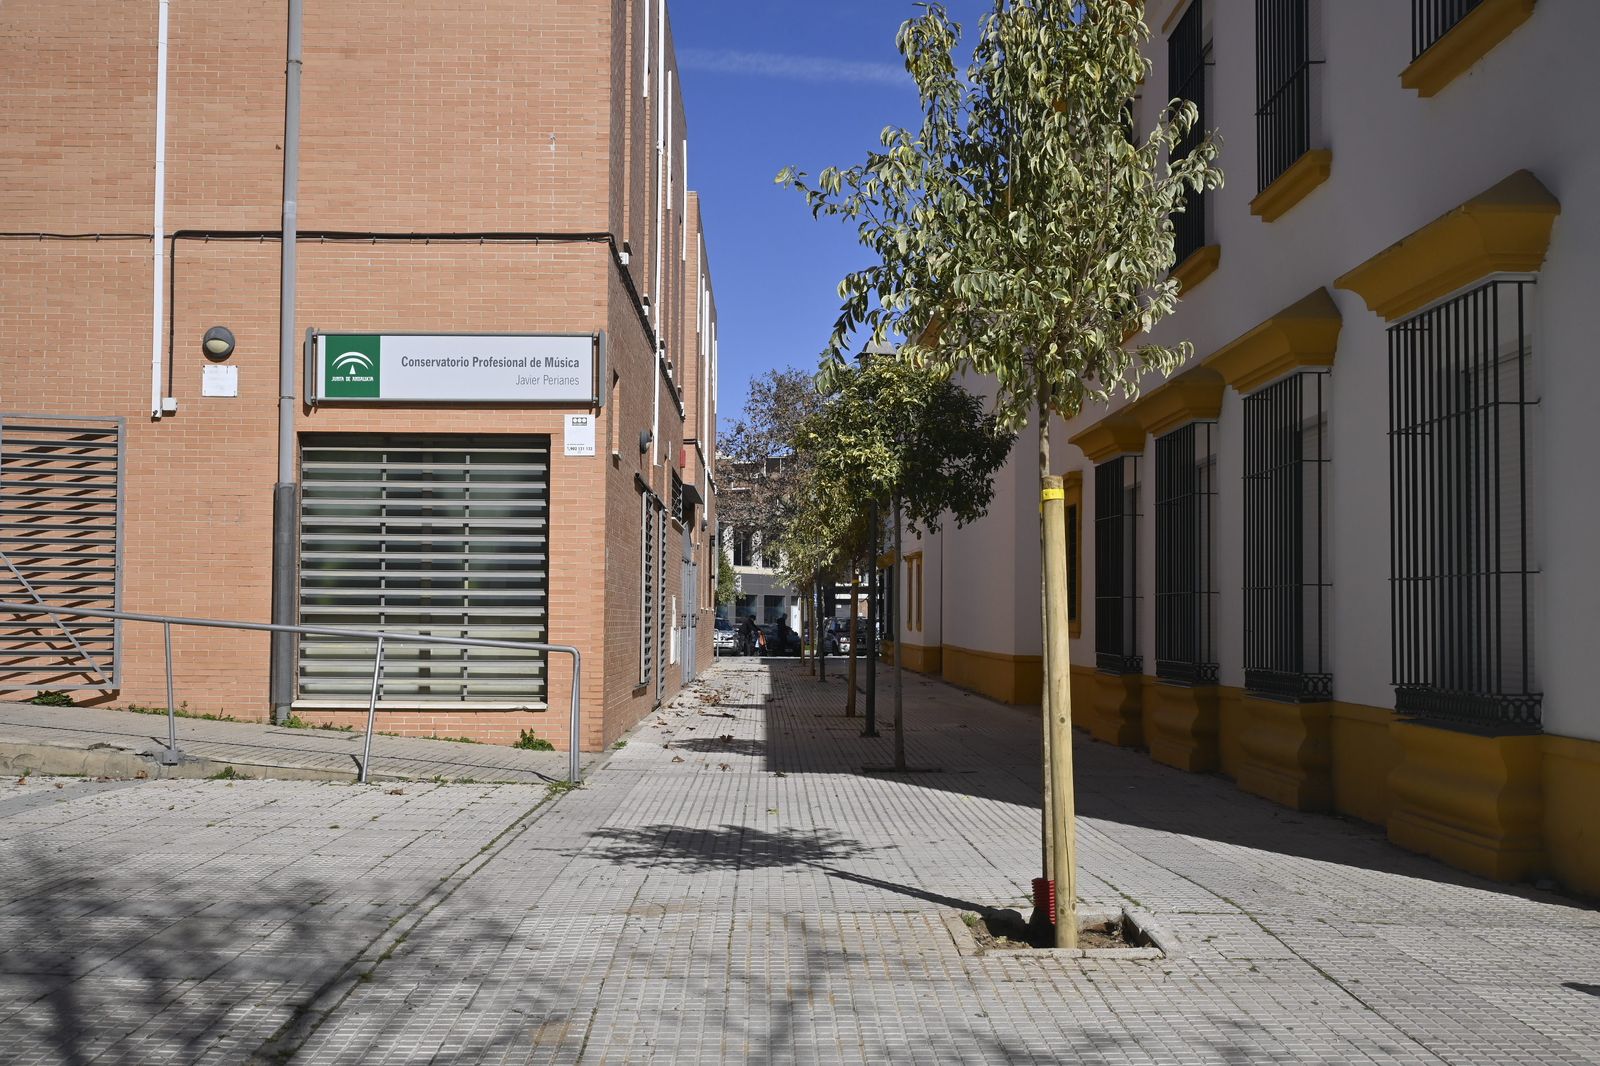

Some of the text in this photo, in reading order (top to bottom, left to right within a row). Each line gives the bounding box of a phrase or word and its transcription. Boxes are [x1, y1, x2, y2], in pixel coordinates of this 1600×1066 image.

[401, 356, 580, 368] Conservatorio Profesional de Música
[515, 374, 580, 386] Javier Perianes
